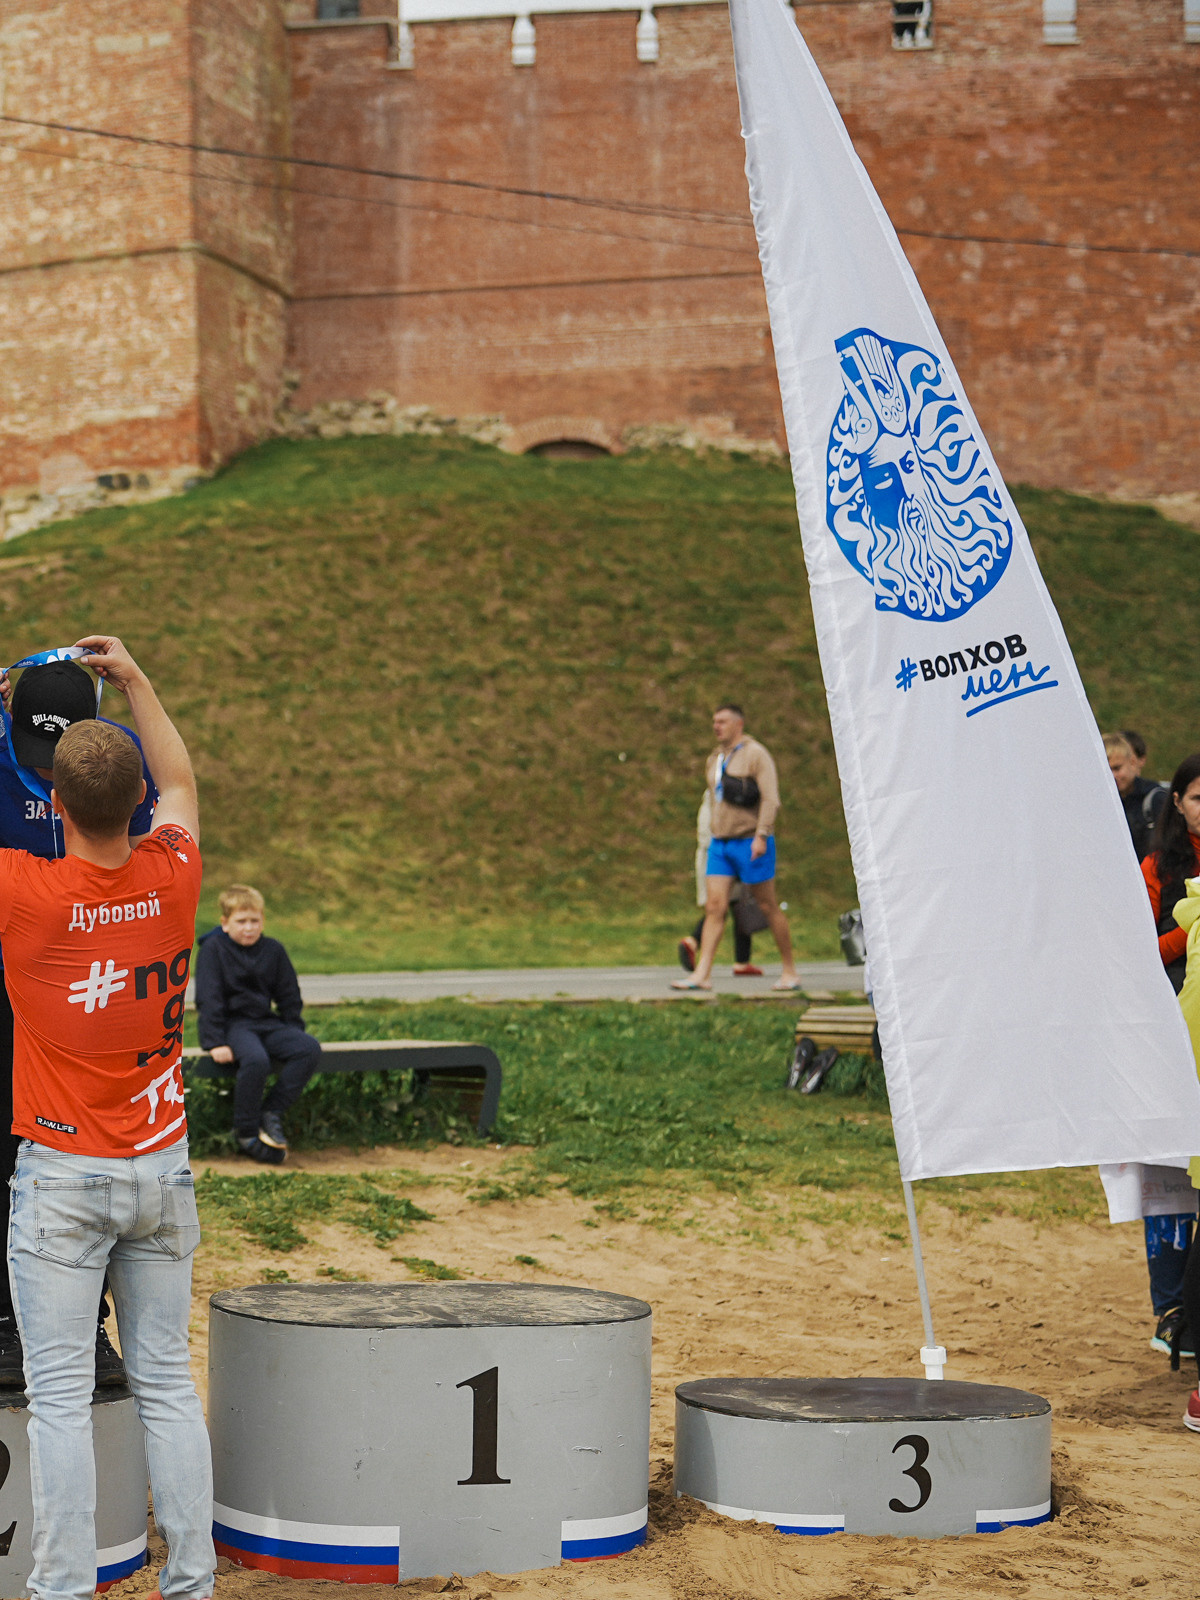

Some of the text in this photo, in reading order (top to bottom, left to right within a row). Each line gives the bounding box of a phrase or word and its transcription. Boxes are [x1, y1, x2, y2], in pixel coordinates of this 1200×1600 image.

[68, 891, 161, 933] Дубовой
[455, 1366, 511, 1486] 1
[888, 1434, 932, 1513] 3
